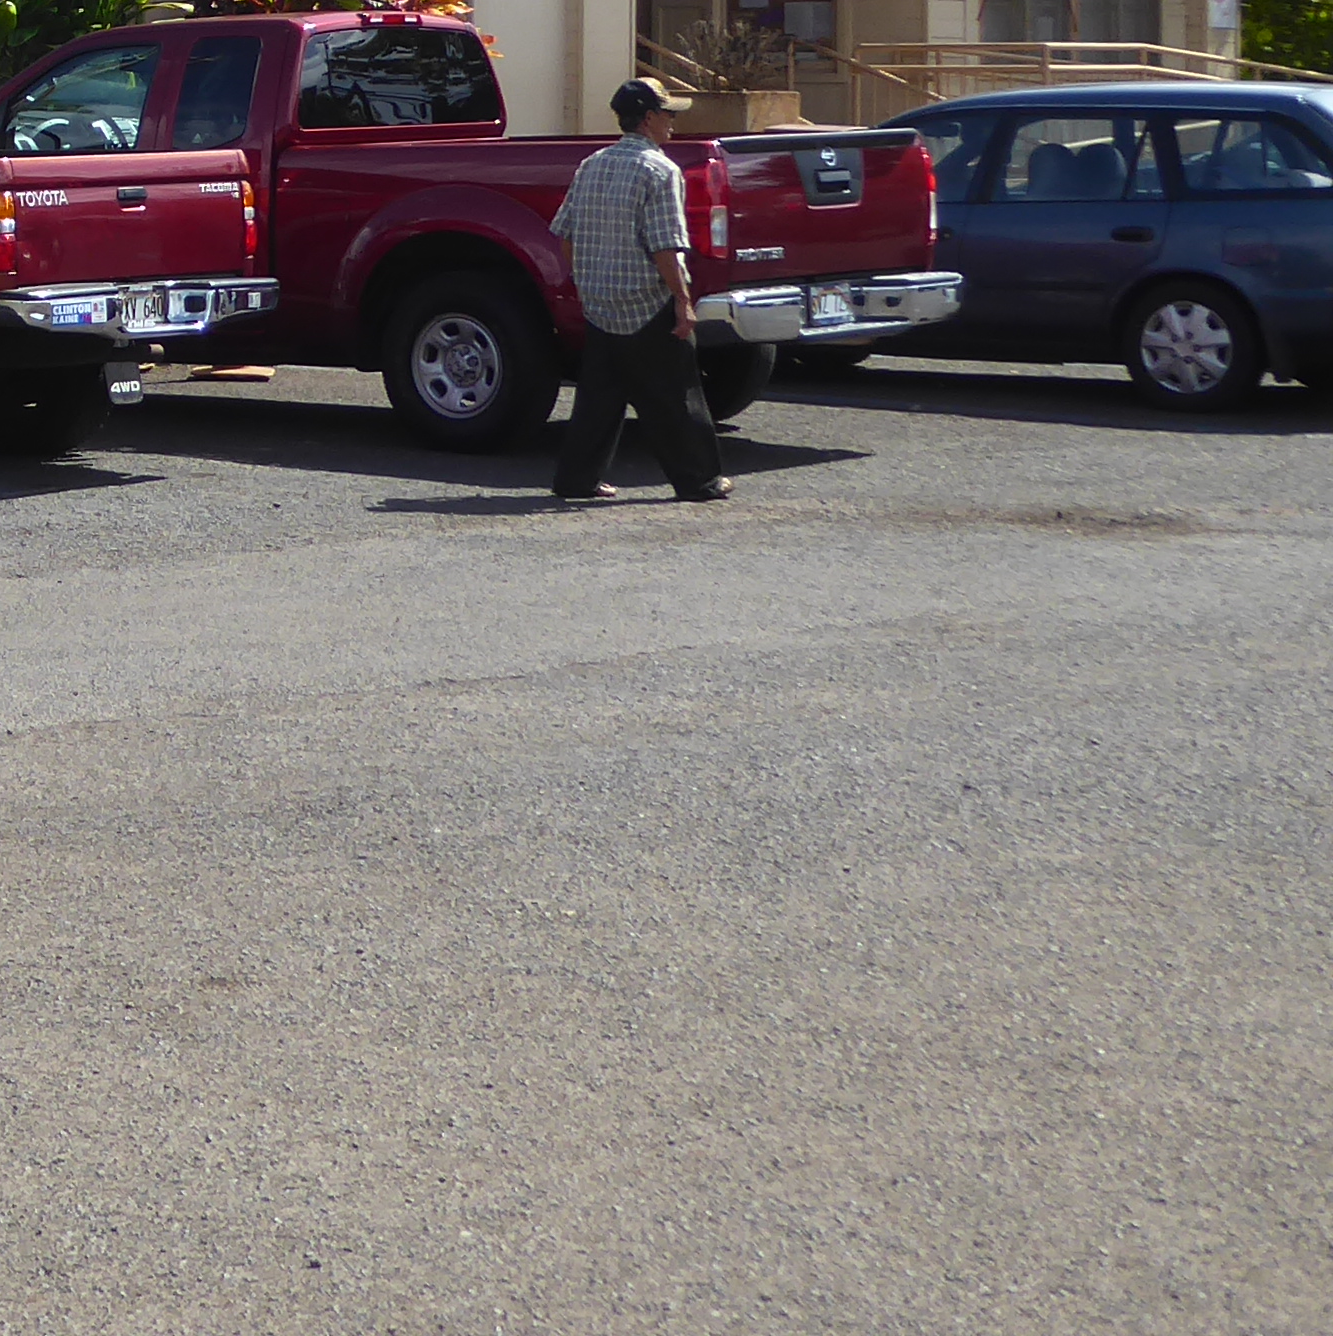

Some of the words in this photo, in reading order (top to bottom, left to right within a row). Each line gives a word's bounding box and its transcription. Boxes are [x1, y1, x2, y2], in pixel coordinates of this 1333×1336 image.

[15, 190, 69, 207] TOYOTA
[53, 303, 92, 316] CLINTON
[143, 296, 164, 320] 640
[111, 381, 141, 394] 4WD
